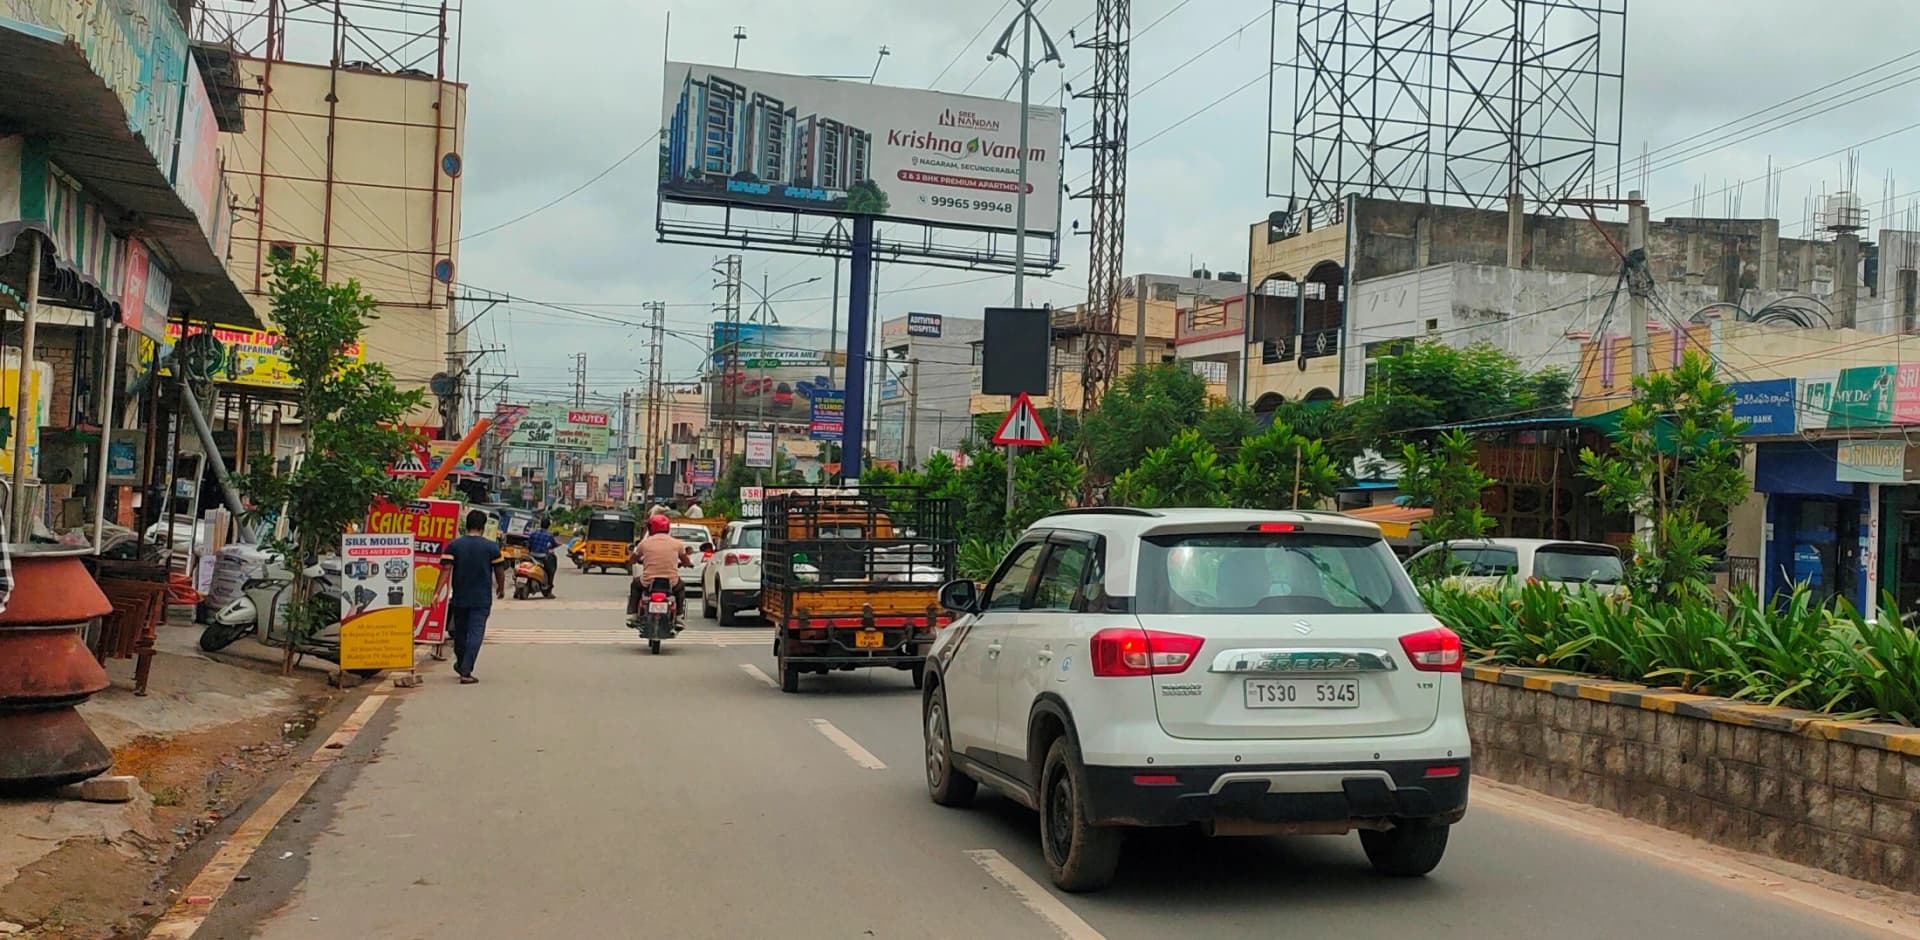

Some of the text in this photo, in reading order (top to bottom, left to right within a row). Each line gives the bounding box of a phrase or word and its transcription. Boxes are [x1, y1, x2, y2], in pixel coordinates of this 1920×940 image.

[957, 117, 1000, 129] NANDAN
[887, 129, 963, 154] Krishna
[922, 174, 939, 183] BHK
[940, 176, 977, 188] PREMIUM
[978, 180, 1029, 192] APARTMENS
[931, 196, 1012, 213] 99965 99948
[909, 324, 939, 334] HOSPITAL
[1900, 368, 1919, 388] SRI
[1753, 415, 1772, 424] BANK
[528, 430, 552, 442] Sale
[1850, 445, 1901, 467] SRINIVASA
[371, 511, 455, 539] CAKE BITE
[370, 537, 409, 546] MOBILE
[1256, 684, 1296, 702] TS30
[1317, 684, 1355, 702] 5345
